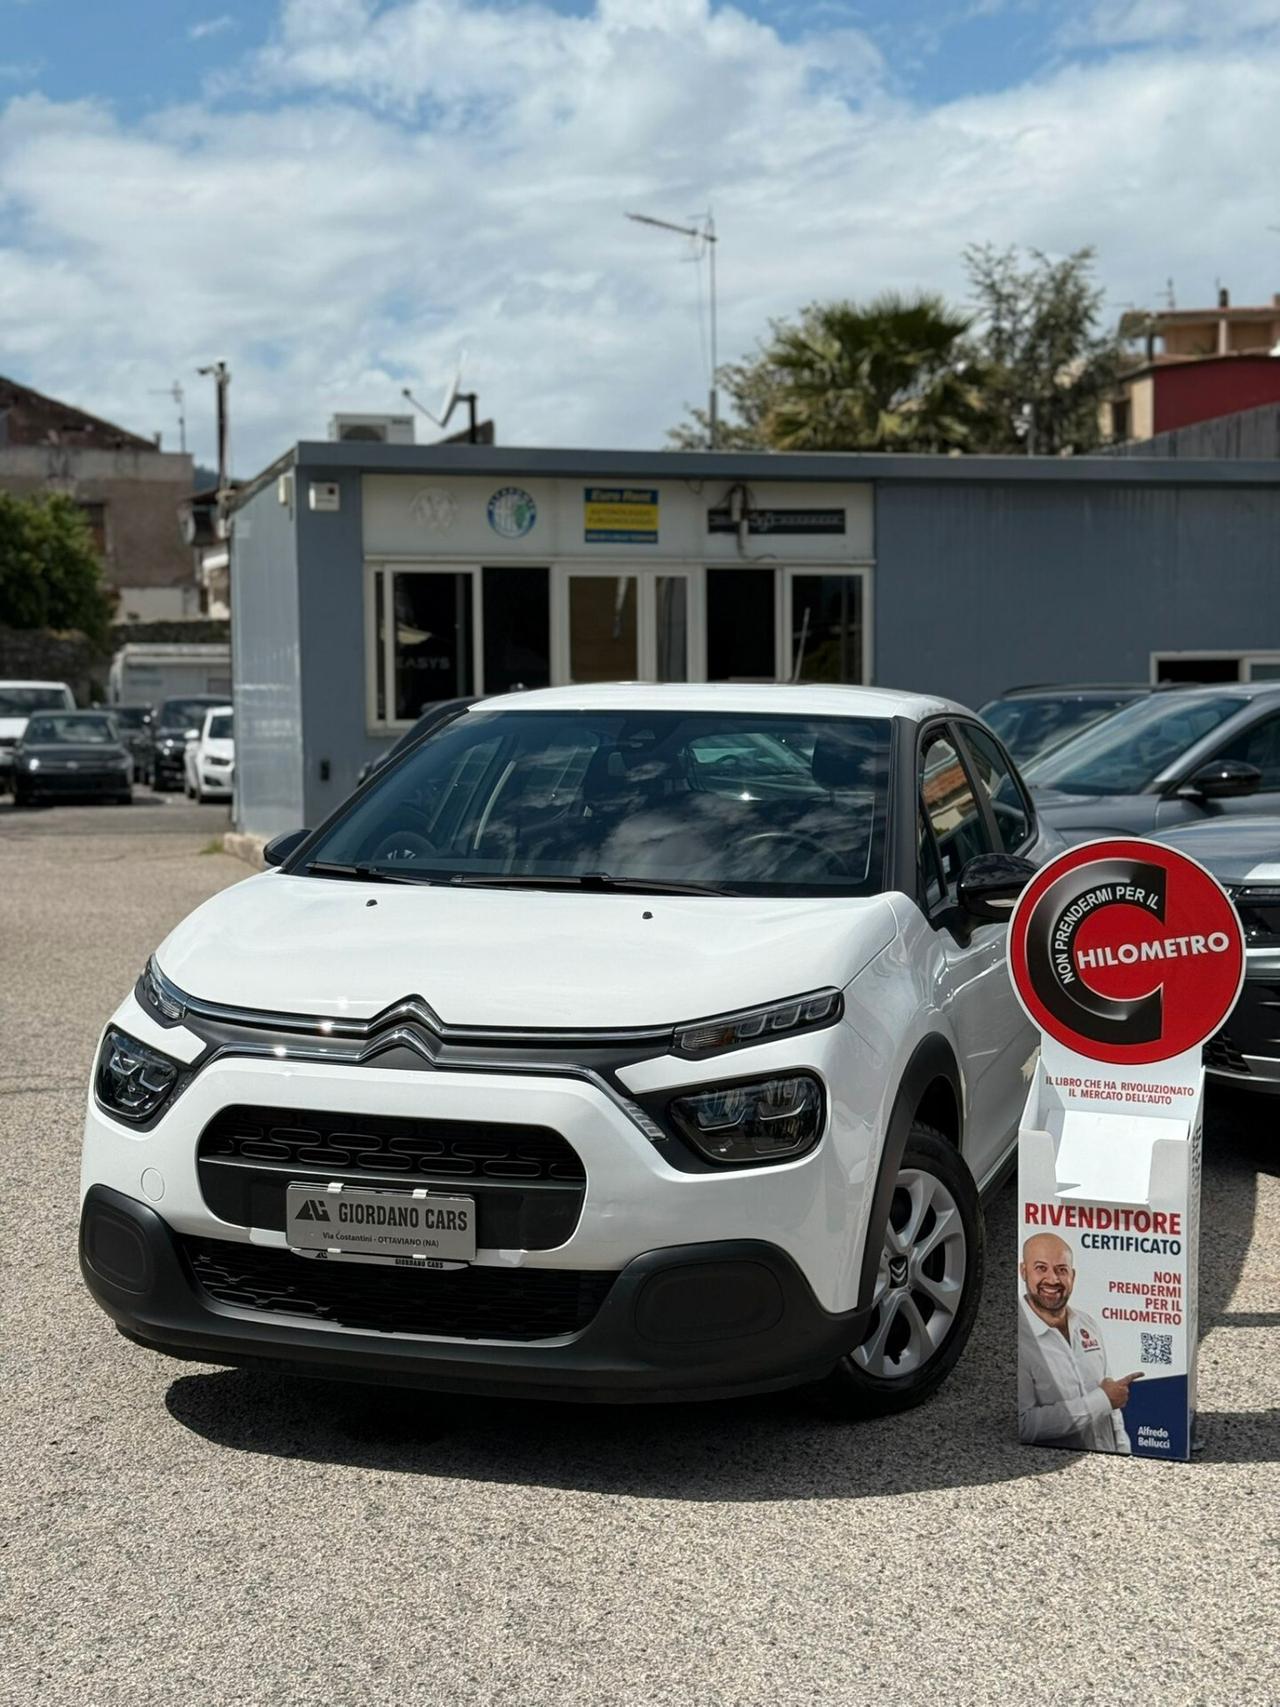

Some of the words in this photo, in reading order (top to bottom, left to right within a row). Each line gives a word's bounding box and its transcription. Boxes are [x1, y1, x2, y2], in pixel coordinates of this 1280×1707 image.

[1116, 886, 1145, 902] PER
[1148, 893, 1159, 910] IL
[1055, 888, 1113, 950] PRENDERMI
[1055, 953, 1075, 984] NON
[1045, 1076, 1054, 1086] IL
[1055, 1077, 1082, 1088] LIBRO
[1084, 1079, 1101, 1089] CHE
[1103, 1080, 1117, 1090] HA
[1120, 1082, 1195, 1096] RIVOLUZIONATO
[1068, 1088, 1077, 1098] IL
[1080, 1089, 1122, 1101] MERCATO
[1125, 1093, 1172, 1105] DELL'AUTO
[338, 1202, 419, 1228] GIORDANO
[425, 1208, 467, 1231] CARS
[1025, 1202, 1181, 1235] RIVENDITORE
[323, 1232, 334, 1240] Via
[335, 1231, 373, 1242] Costantini
[378, 1235, 422, 1246] OTTAVIANO
[423, 1239, 440, 1248] (NA)
[1081, 1233, 1181, 1255] CERTIFICATO
[395, 1258, 426, 1267] GIORDANO
[1153, 1271, 1181, 1285] NON
[1108, 1281, 1181, 1298] PRENDERMI
[1145, 1297, 1168, 1311] PER
[1171, 1299, 1182, 1312] IL
[1102, 1307, 1182, 1325] CHILOMETRO
[1137, 1426, 1168, 1438] Alfredo
[1138, 1437, 1170, 1449] Bellucci
